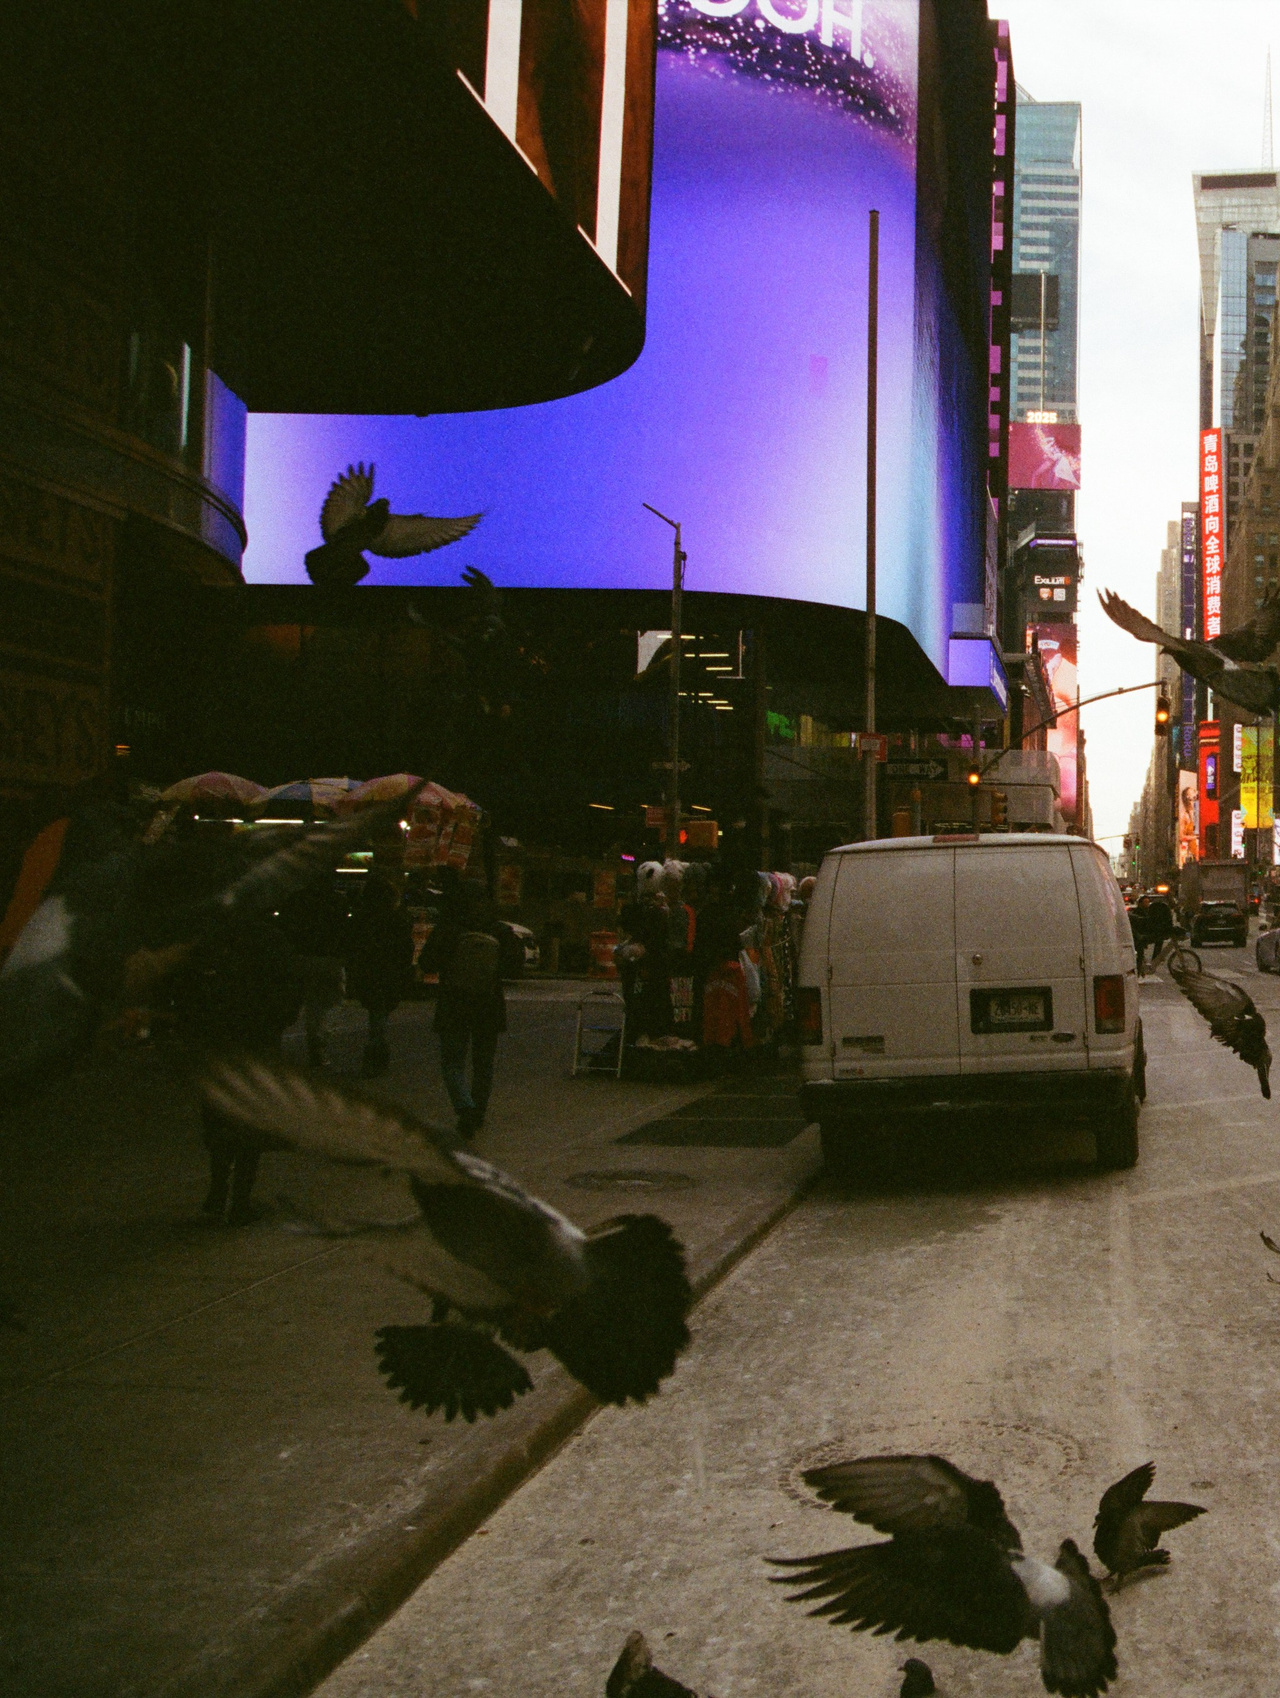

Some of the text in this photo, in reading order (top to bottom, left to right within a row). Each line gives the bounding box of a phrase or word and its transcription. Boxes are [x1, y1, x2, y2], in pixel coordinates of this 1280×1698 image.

[1027, 411, 1058, 424] 2025
[1203, 433, 1222, 640] 青岛啤酒向全球消费者
